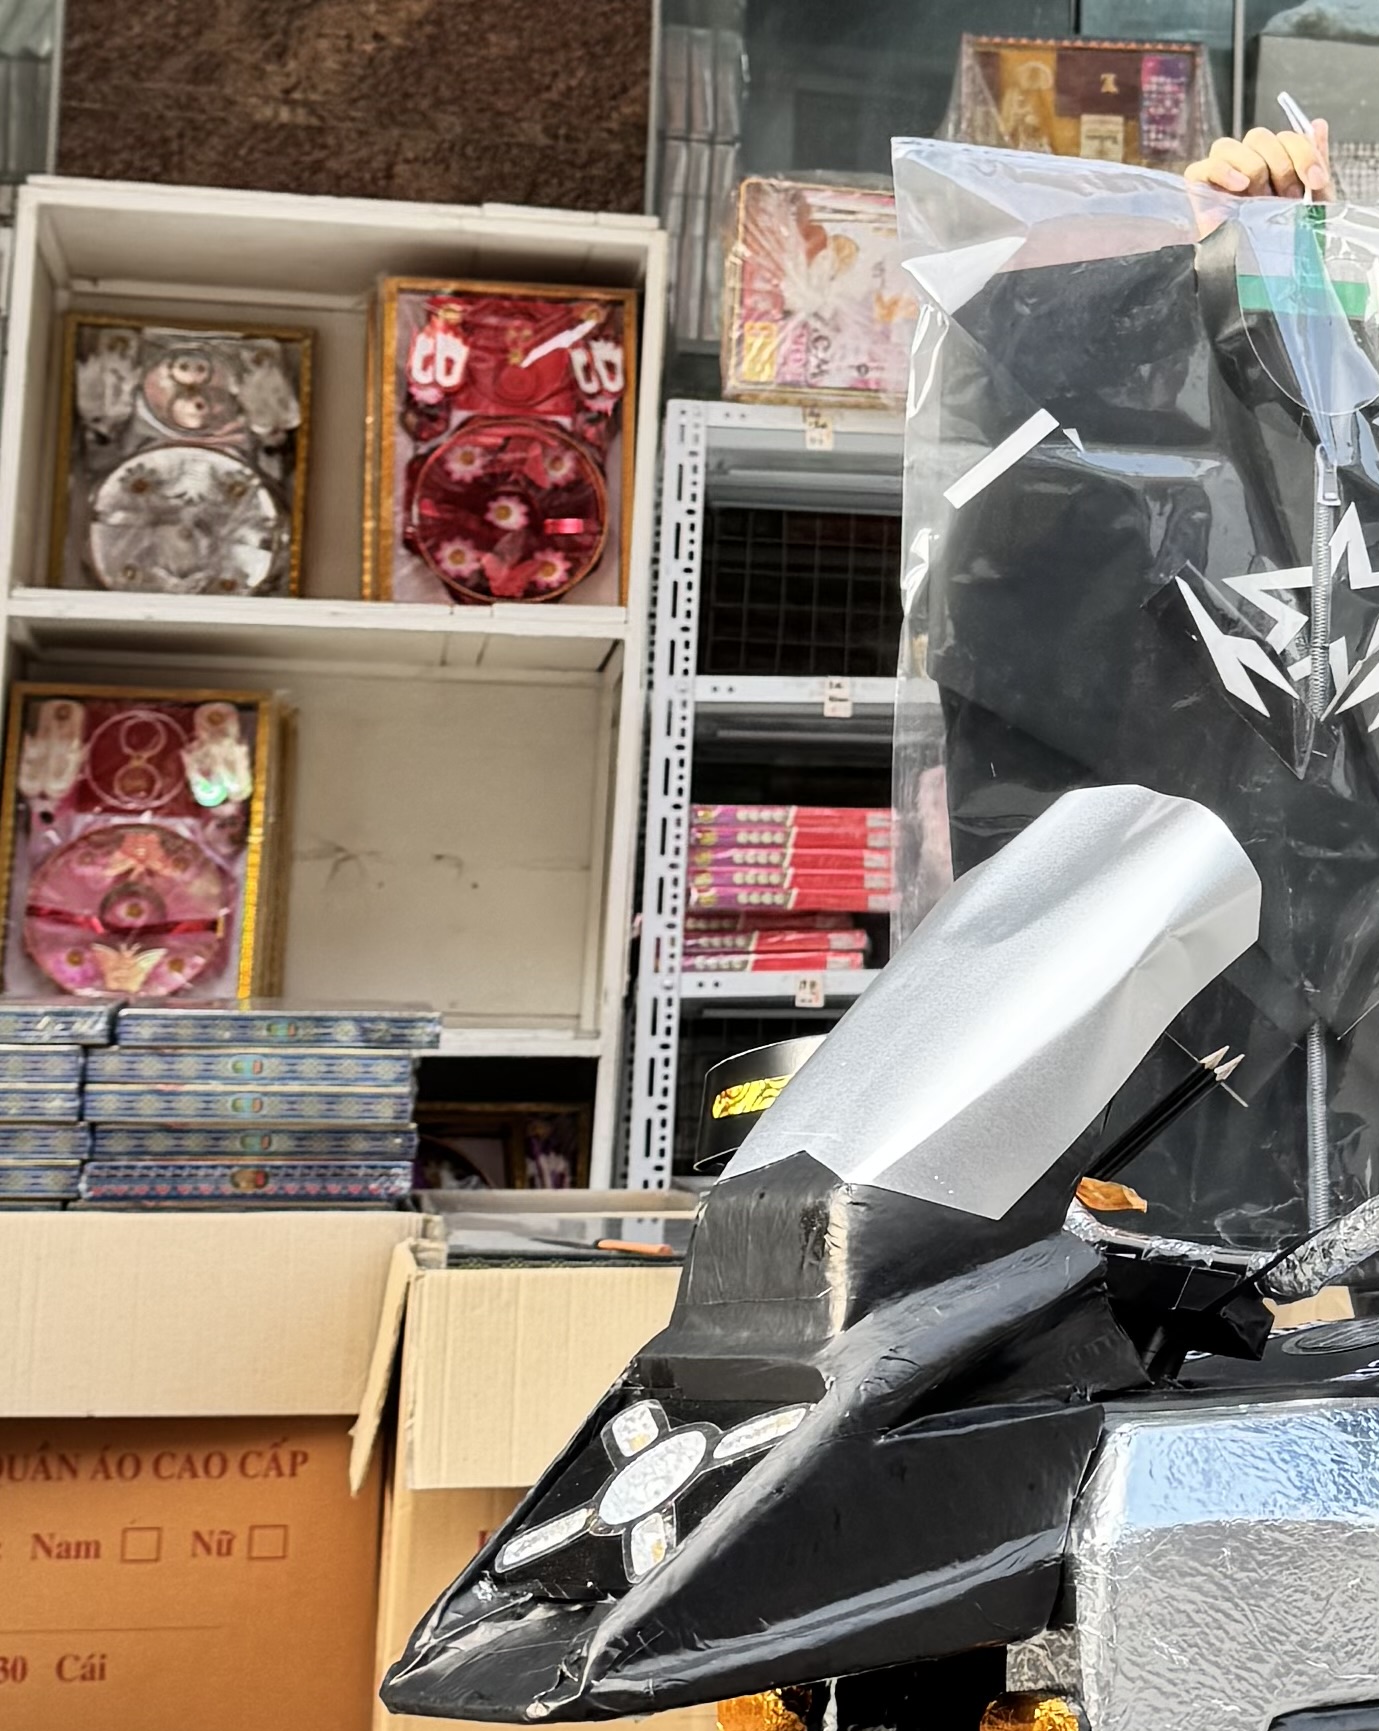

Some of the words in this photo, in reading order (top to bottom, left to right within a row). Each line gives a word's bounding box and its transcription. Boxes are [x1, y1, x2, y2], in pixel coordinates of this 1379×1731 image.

[90, 1446, 142, 1482] ÁO
[153, 1451, 229, 1480] CAO
[239, 1438, 309, 1479] CẤP
[30, 1532, 101, 1561] Nam
[192, 1530, 236, 1558] Nữ
[55, 1652, 107, 1683] Cái
